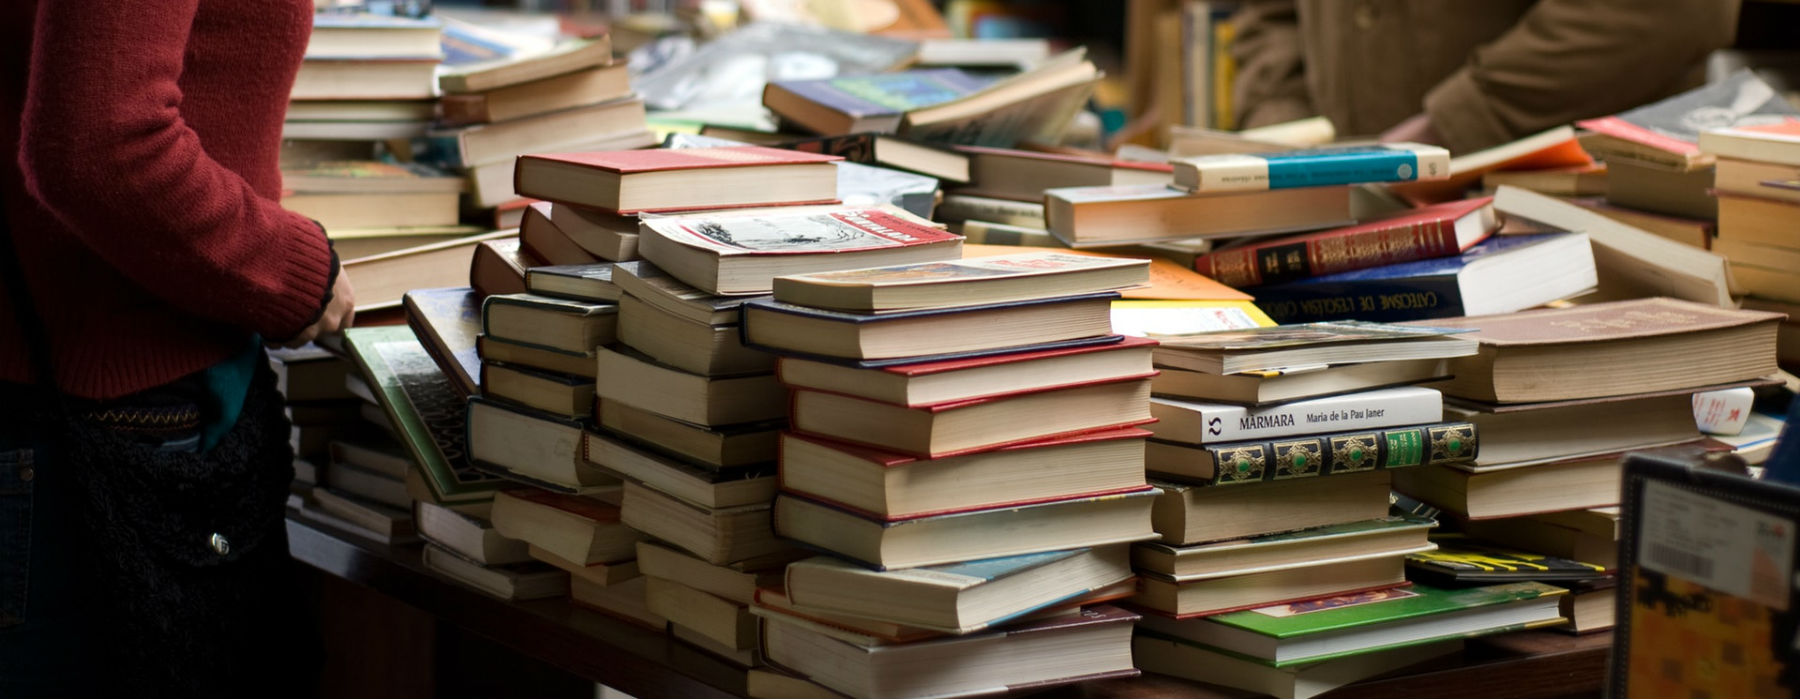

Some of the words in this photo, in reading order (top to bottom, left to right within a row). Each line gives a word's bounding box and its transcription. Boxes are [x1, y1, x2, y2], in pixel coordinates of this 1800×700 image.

[1360, 294, 1375, 312] DE
[1380, 291, 1437, 311] CATECISME
[1239, 413, 1295, 430] MÀRMARA
[1306, 412, 1328, 423] Maria
[1329, 410, 1338, 421] de
[1340, 410, 1348, 420] la
[1350, 409, 1364, 419] Pau
[1365, 408, 1385, 419] Janer
